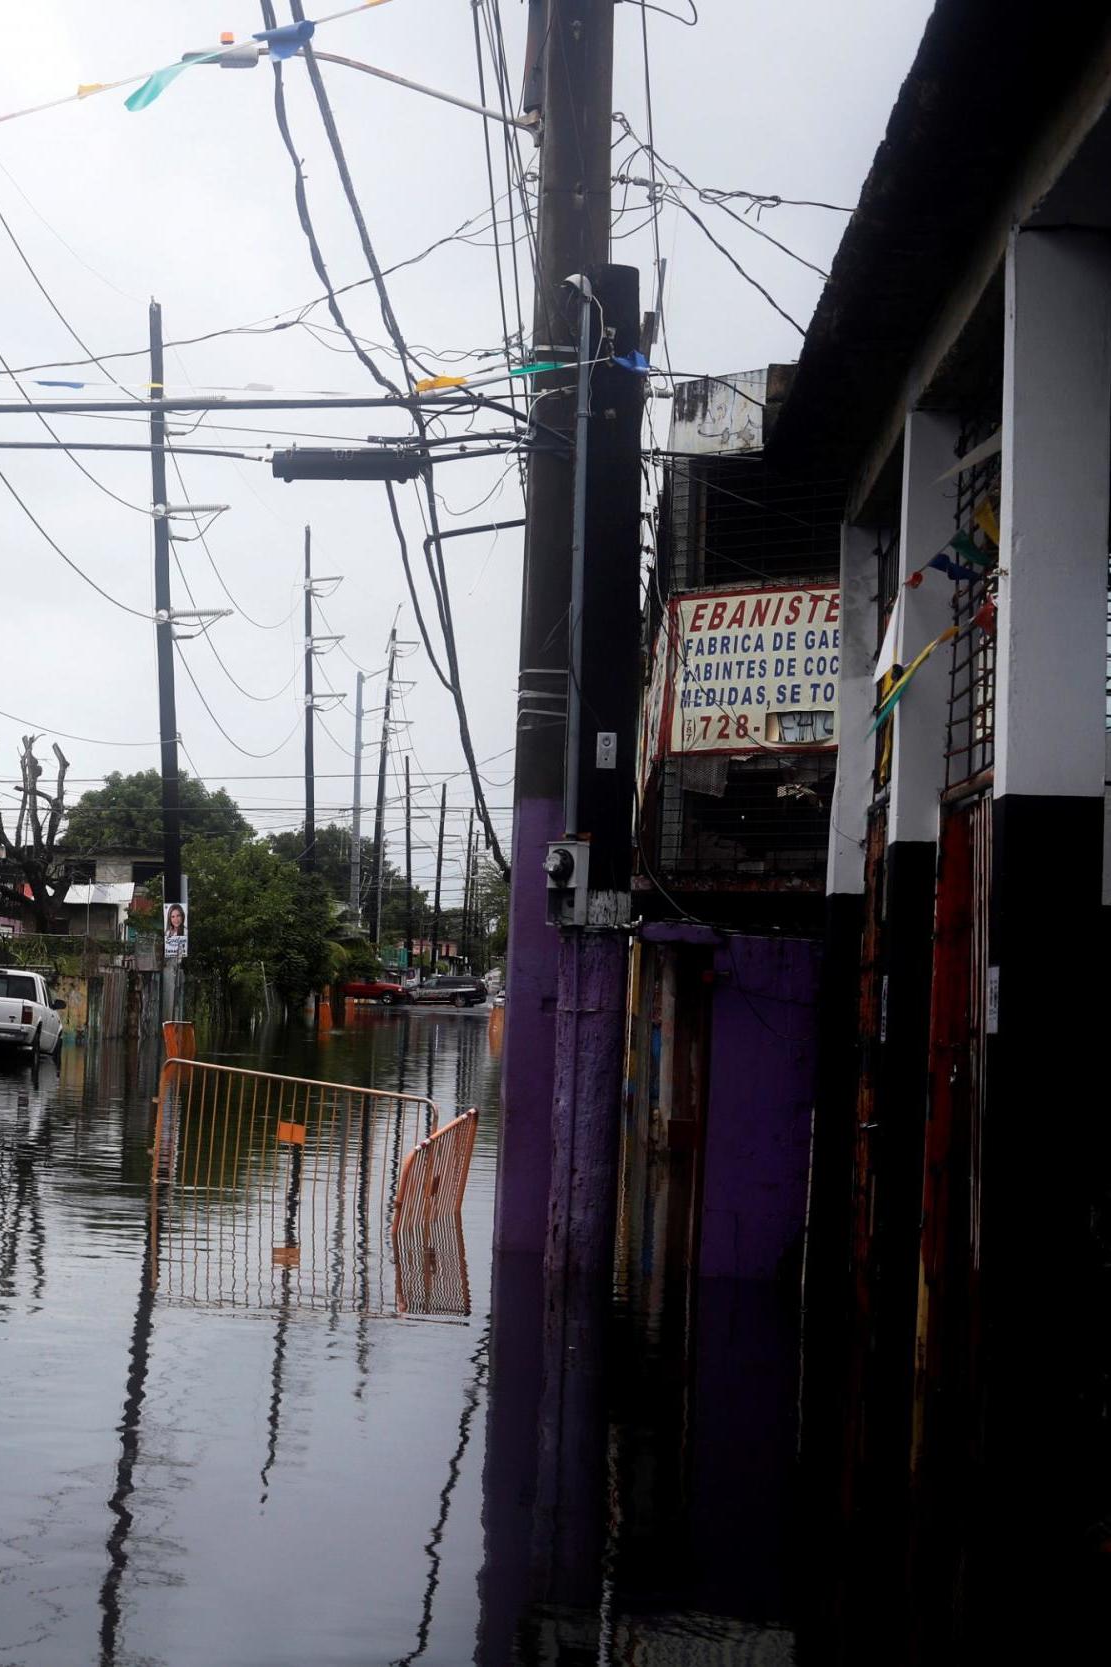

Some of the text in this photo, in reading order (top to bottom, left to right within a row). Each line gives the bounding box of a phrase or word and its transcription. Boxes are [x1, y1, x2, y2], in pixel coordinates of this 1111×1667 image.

[686, 637, 764, 657] FABRICA
[772, 632, 796, 651] DE
[774, 658, 796, 677] DE
[776, 684, 801, 704] SE
[810, 683, 835, 702] TO
